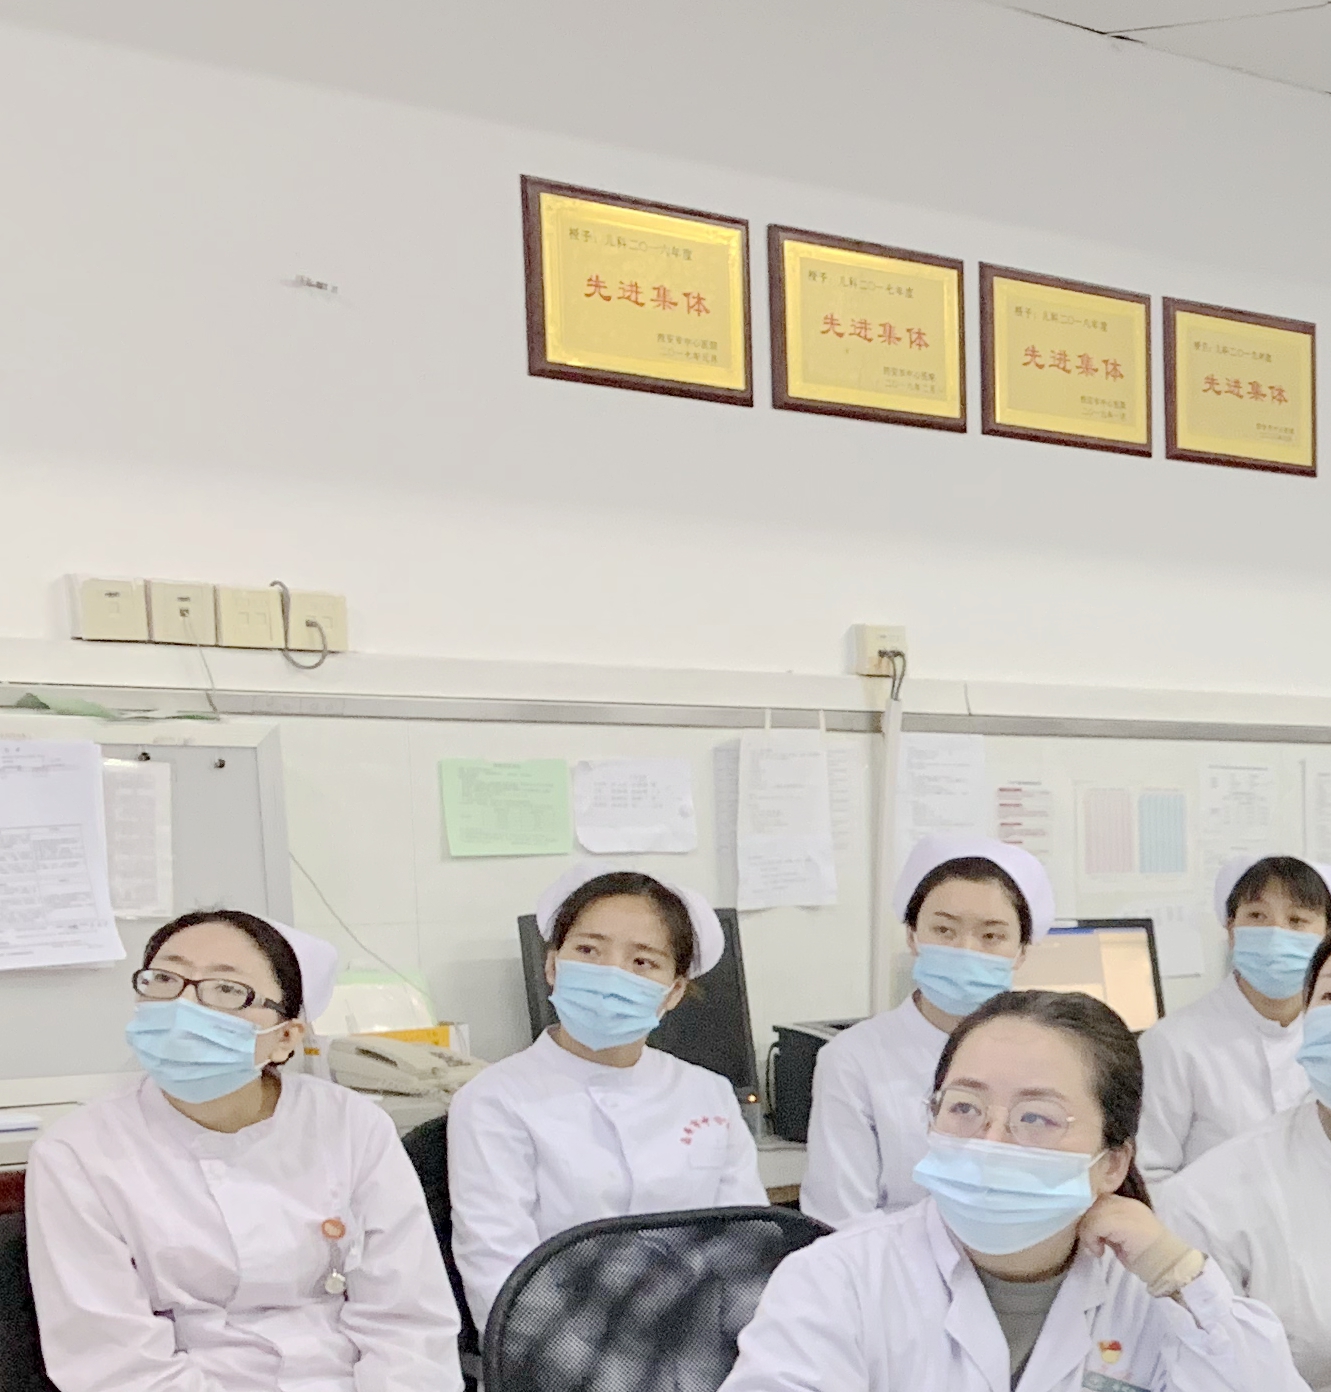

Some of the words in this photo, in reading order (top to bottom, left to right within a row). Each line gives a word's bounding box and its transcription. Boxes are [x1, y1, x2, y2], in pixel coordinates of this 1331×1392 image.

[584, 274, 711, 317] 先进集体
[820, 312, 930, 351] 先进集体
[1022, 344, 1125, 382] 先进集体
[1202, 373, 1289, 406] 先进集体
